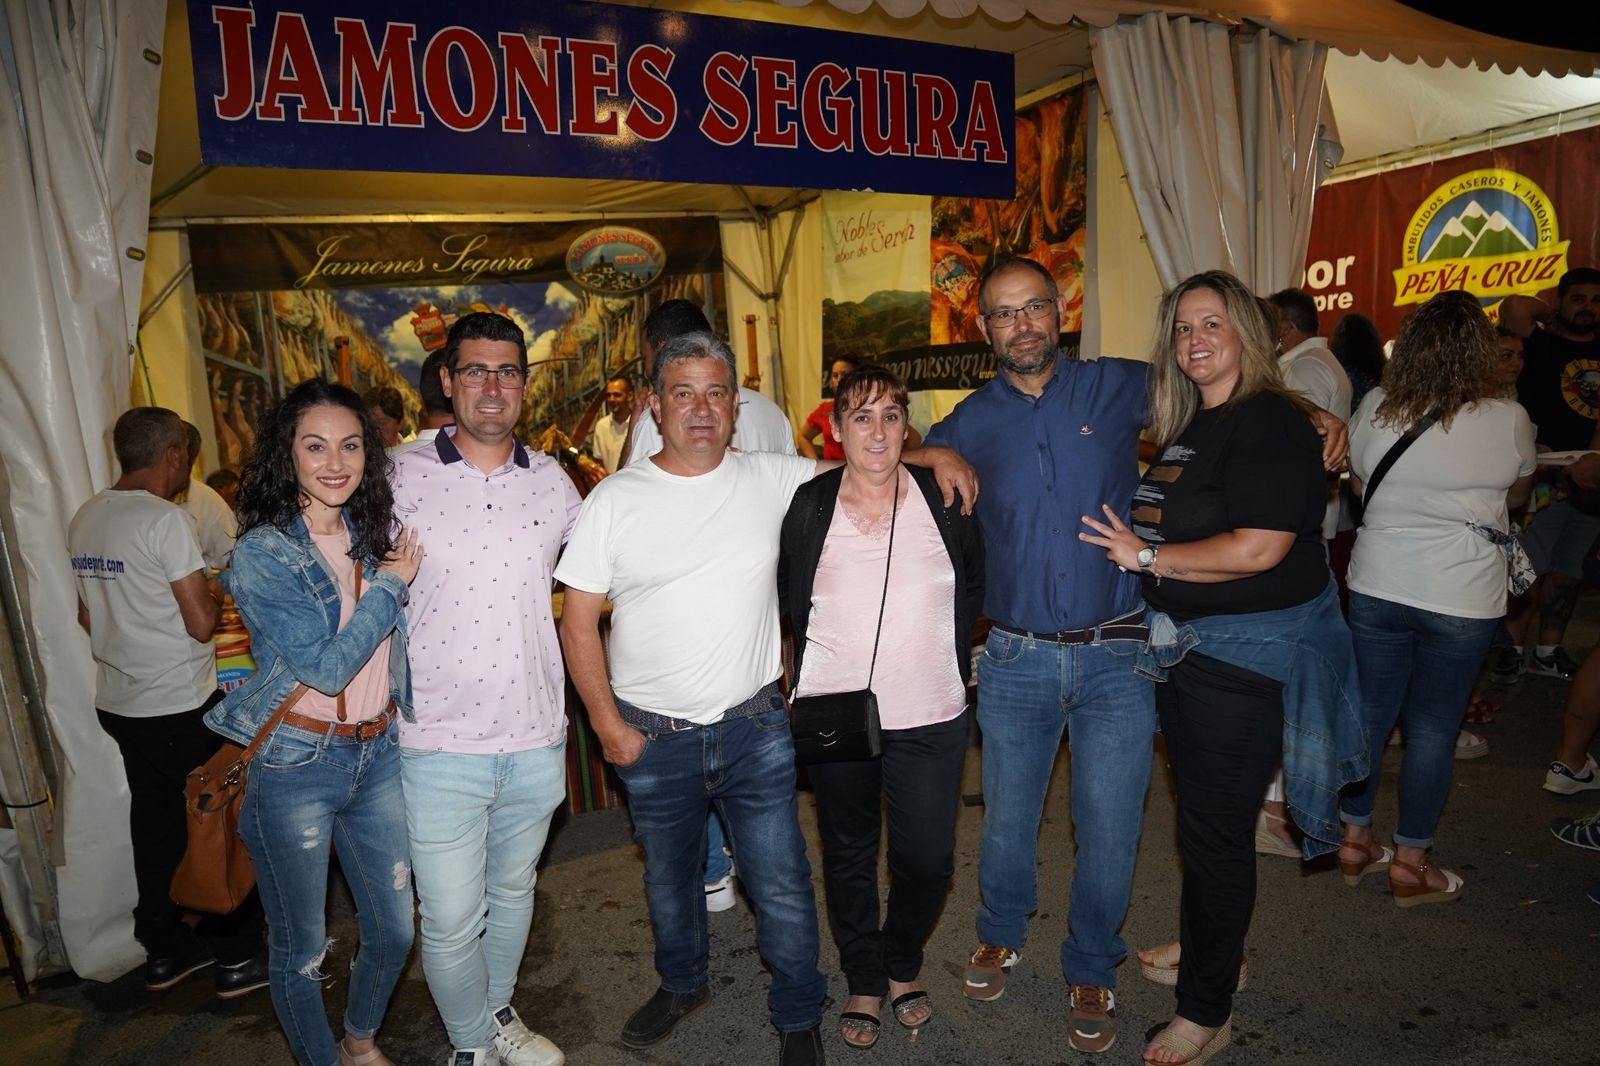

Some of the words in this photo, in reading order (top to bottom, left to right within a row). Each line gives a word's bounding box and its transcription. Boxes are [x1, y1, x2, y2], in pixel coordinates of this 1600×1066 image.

[212, 5, 677, 142] JAMONES
[700, 50, 1007, 163] SEGURA
[1408, 196, 1443, 261] EMBUTIDOS
[1450, 176, 1505, 195] CASEROS
[1512, 182, 1521, 191] Y
[1523, 190, 1552, 242] JAMONES
[293, 235, 425, 289] Jamones
[433, 234, 533, 283] Segura
[1301, 256, 1355, 289] or
[1400, 262, 1470, 297] PEÑA
[1481, 253, 1563, 288] CRUZ
